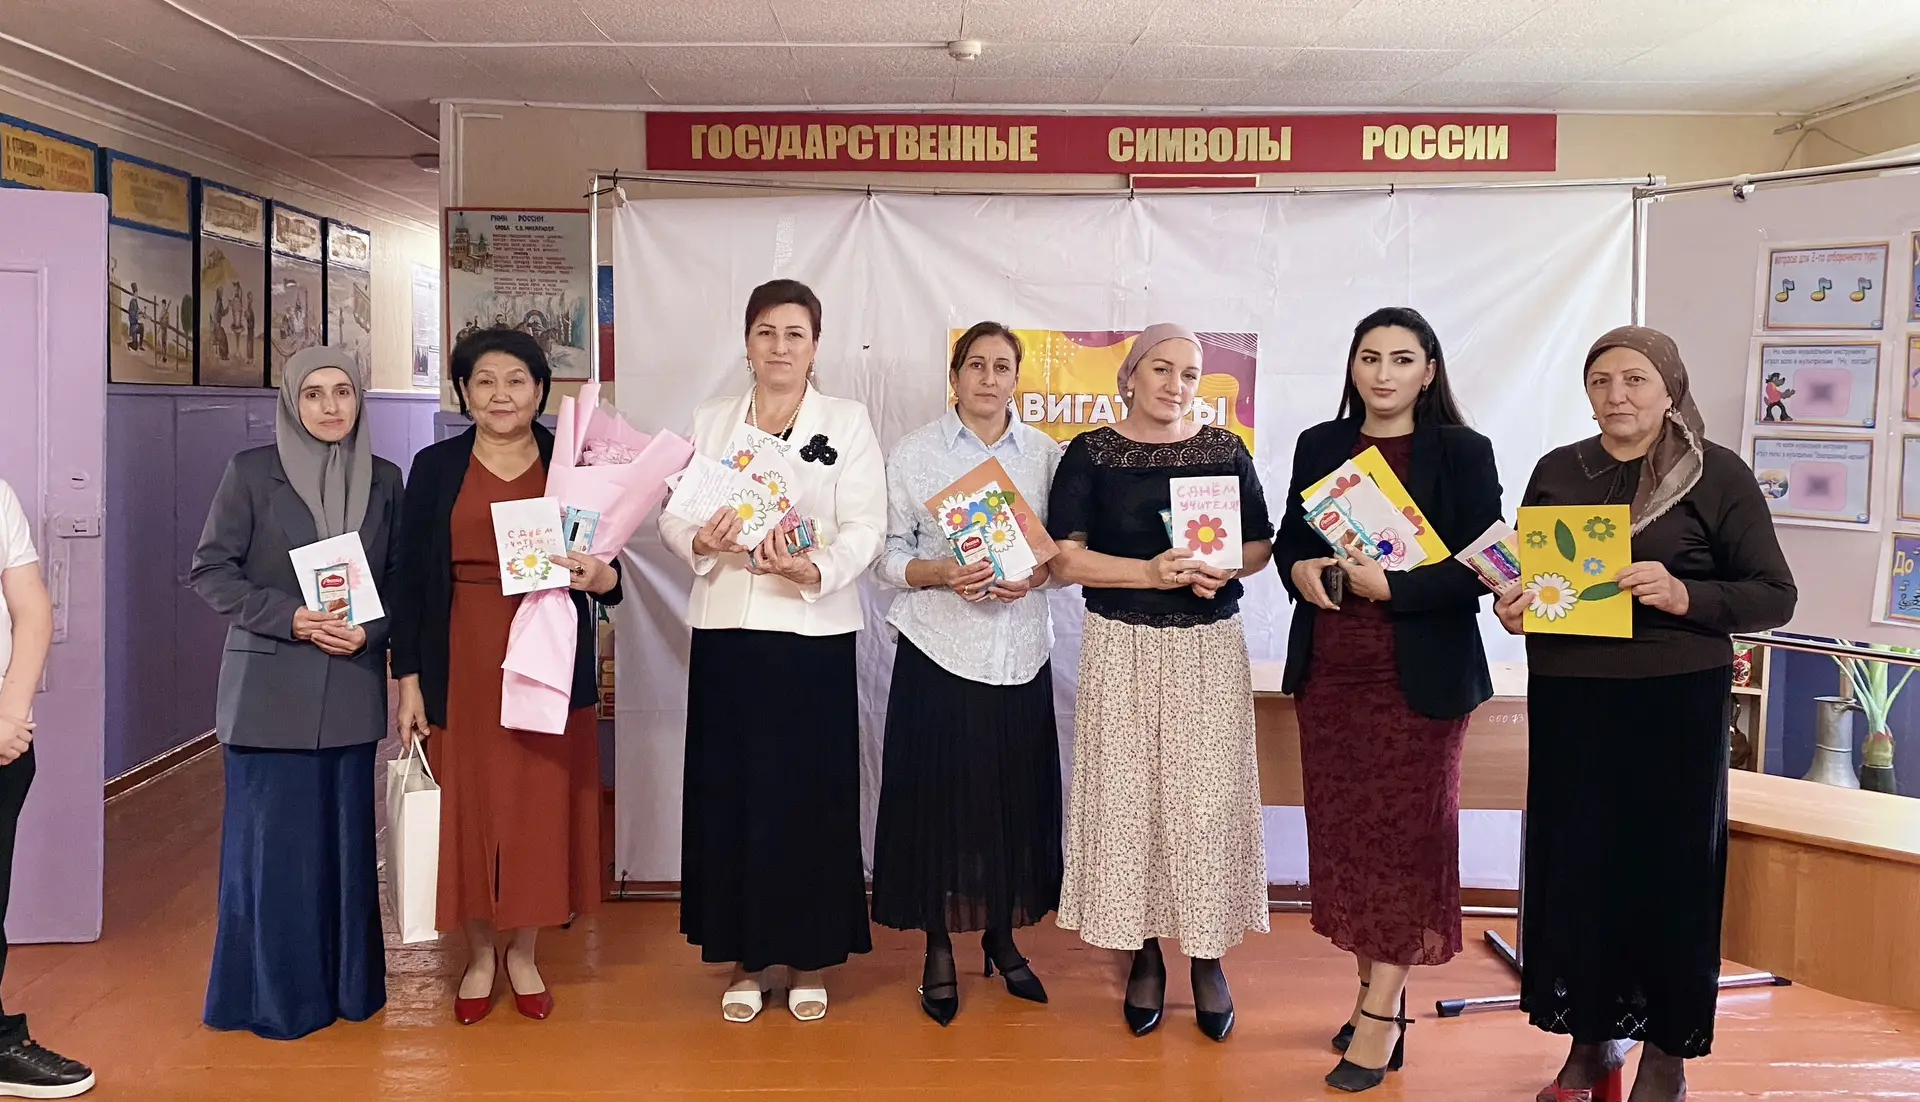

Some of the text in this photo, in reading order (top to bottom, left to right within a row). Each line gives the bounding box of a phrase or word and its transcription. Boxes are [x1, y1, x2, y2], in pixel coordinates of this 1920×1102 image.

[691, 124, 1509, 162] ГОСУДАРСТВЕННЫЕ СИМВОЛЫ РОССИИ
